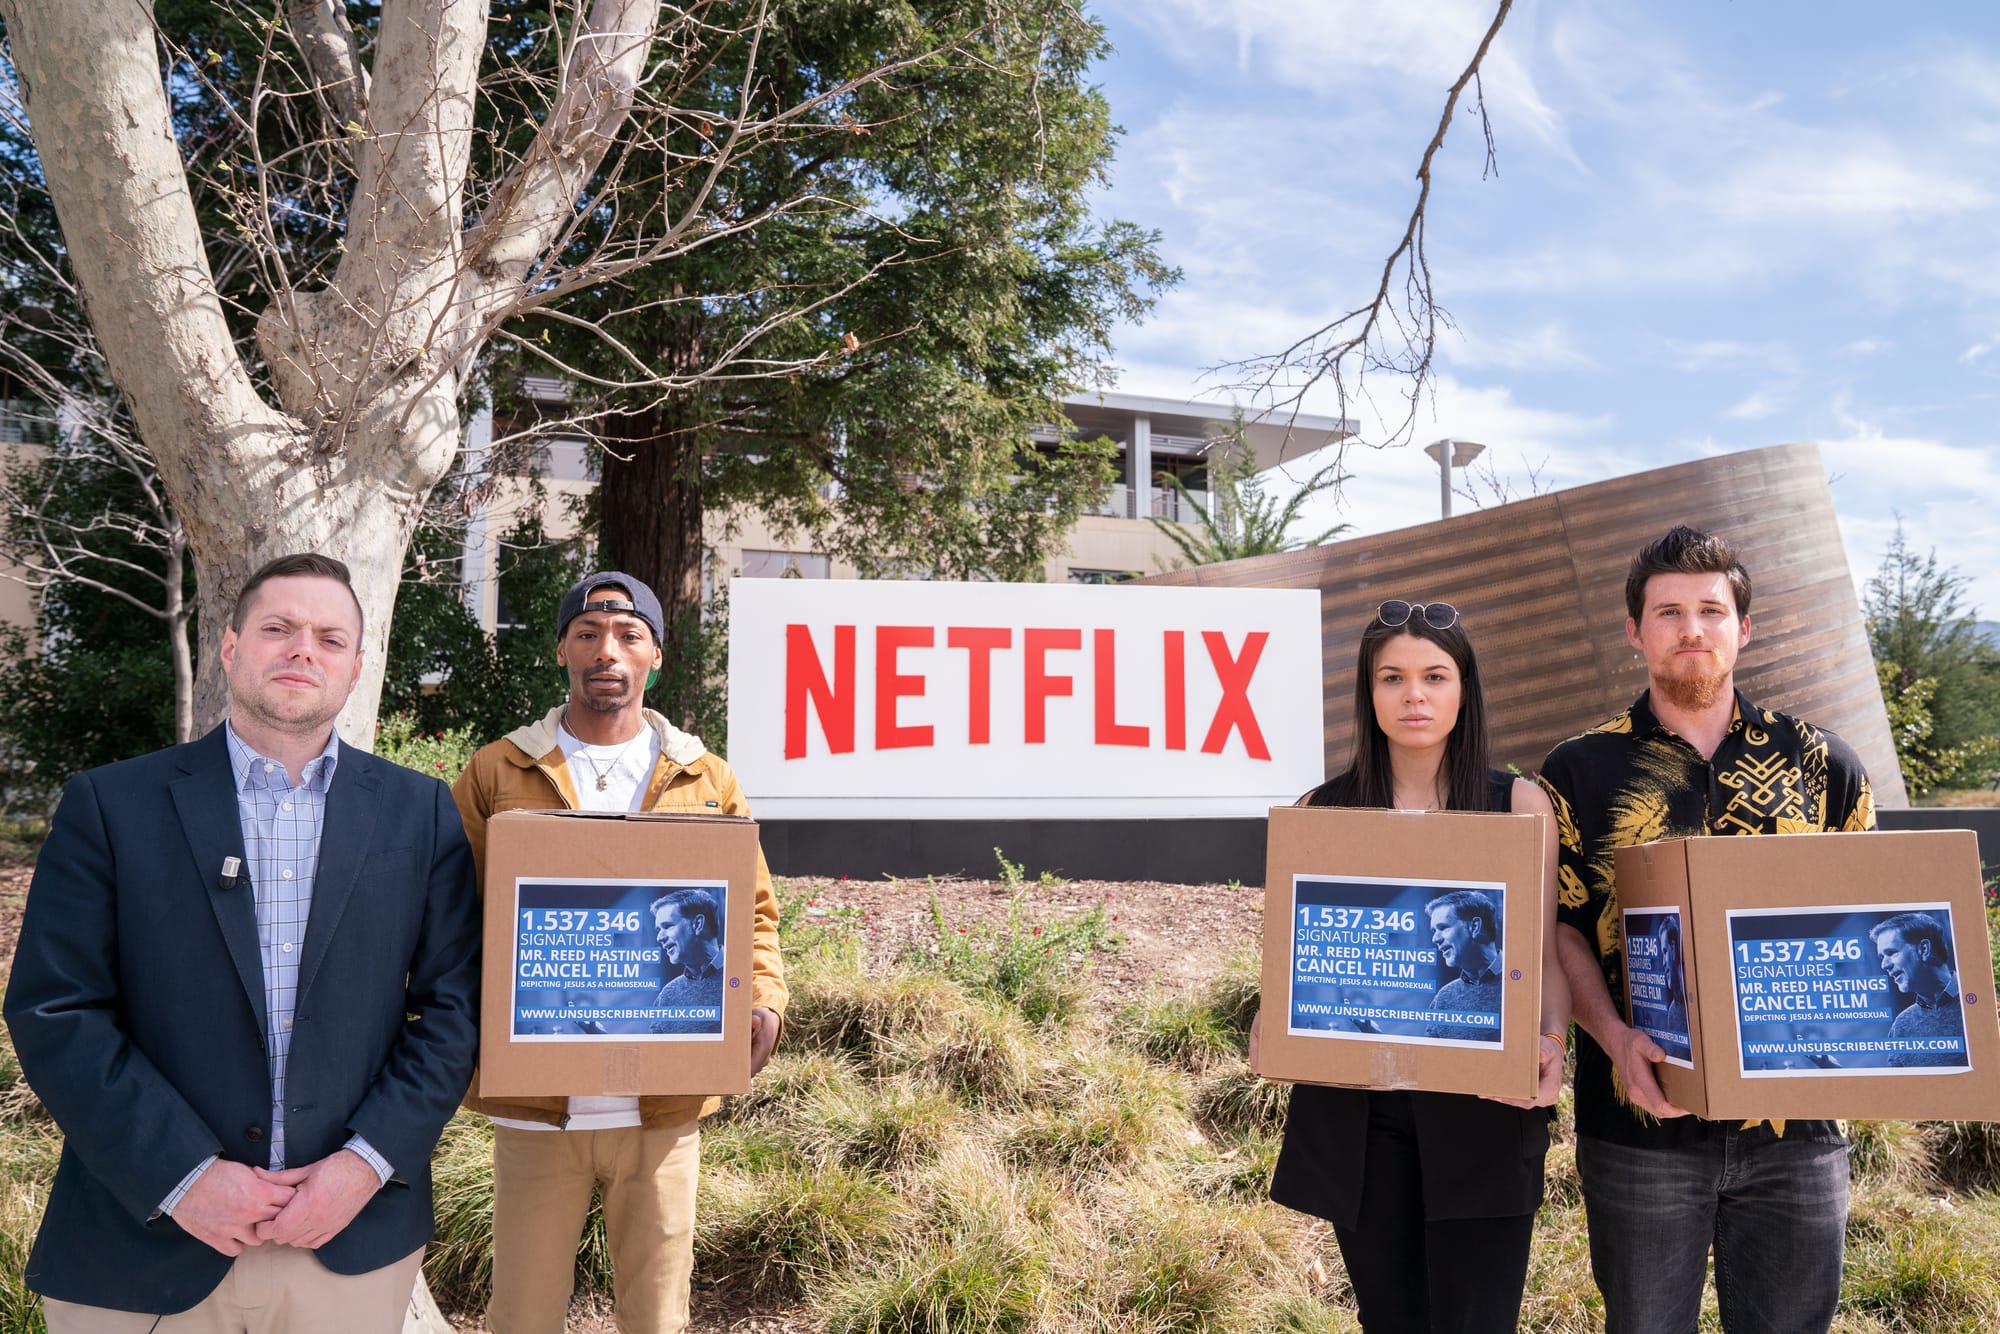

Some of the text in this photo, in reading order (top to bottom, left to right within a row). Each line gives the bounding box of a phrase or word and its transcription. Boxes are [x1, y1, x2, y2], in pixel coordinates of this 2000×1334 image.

[784, 623, 1272, 762] NETFLIX
[522, 910, 640, 932] 1.537.346
[1299, 907, 1415, 931] 1.537.346
[520, 934, 612, 946] SIGNATURES
[1297, 929, 1387, 945] SIGNATURES
[520, 950, 659, 961] MR. REED HASTINGS
[1297, 945, 1435, 963] MR. REED HASTINGS
[1737, 939, 1861, 963] 1.537.346
[520, 963, 639, 977] CANCEL FILM
[1297, 958, 1414, 978] CANCEL FILM
[1738, 964, 1834, 979] SIGNATURES
[563, 981, 585, 989] JESUS
[1297, 976, 1336, 984] DEPICTING
[1339, 978, 1360, 986] JESUS
[1380, 981, 1433, 989] HOMOSEXUAL
[1740, 979, 1887, 994] MR. REED HASTINGS
[1649, 985, 1662, 1001] FILM
[1742, 993, 1868, 1011] CANCEL FILM
[521, 1009, 716, 1019] WWW.UNSUBSCRIBENETFLIX.COM
[1298, 1004, 1494, 1025] WWW.UNSUBSCRIBENETFLIX.COM
[1789, 1013, 1812, 1021] JESUS
[1833, 1011, 1889, 1019] HOMOSEXUAL
[1749, 1040, 1959, 1053] WWW.UNSUBSCRIBENETFLIX.COM
